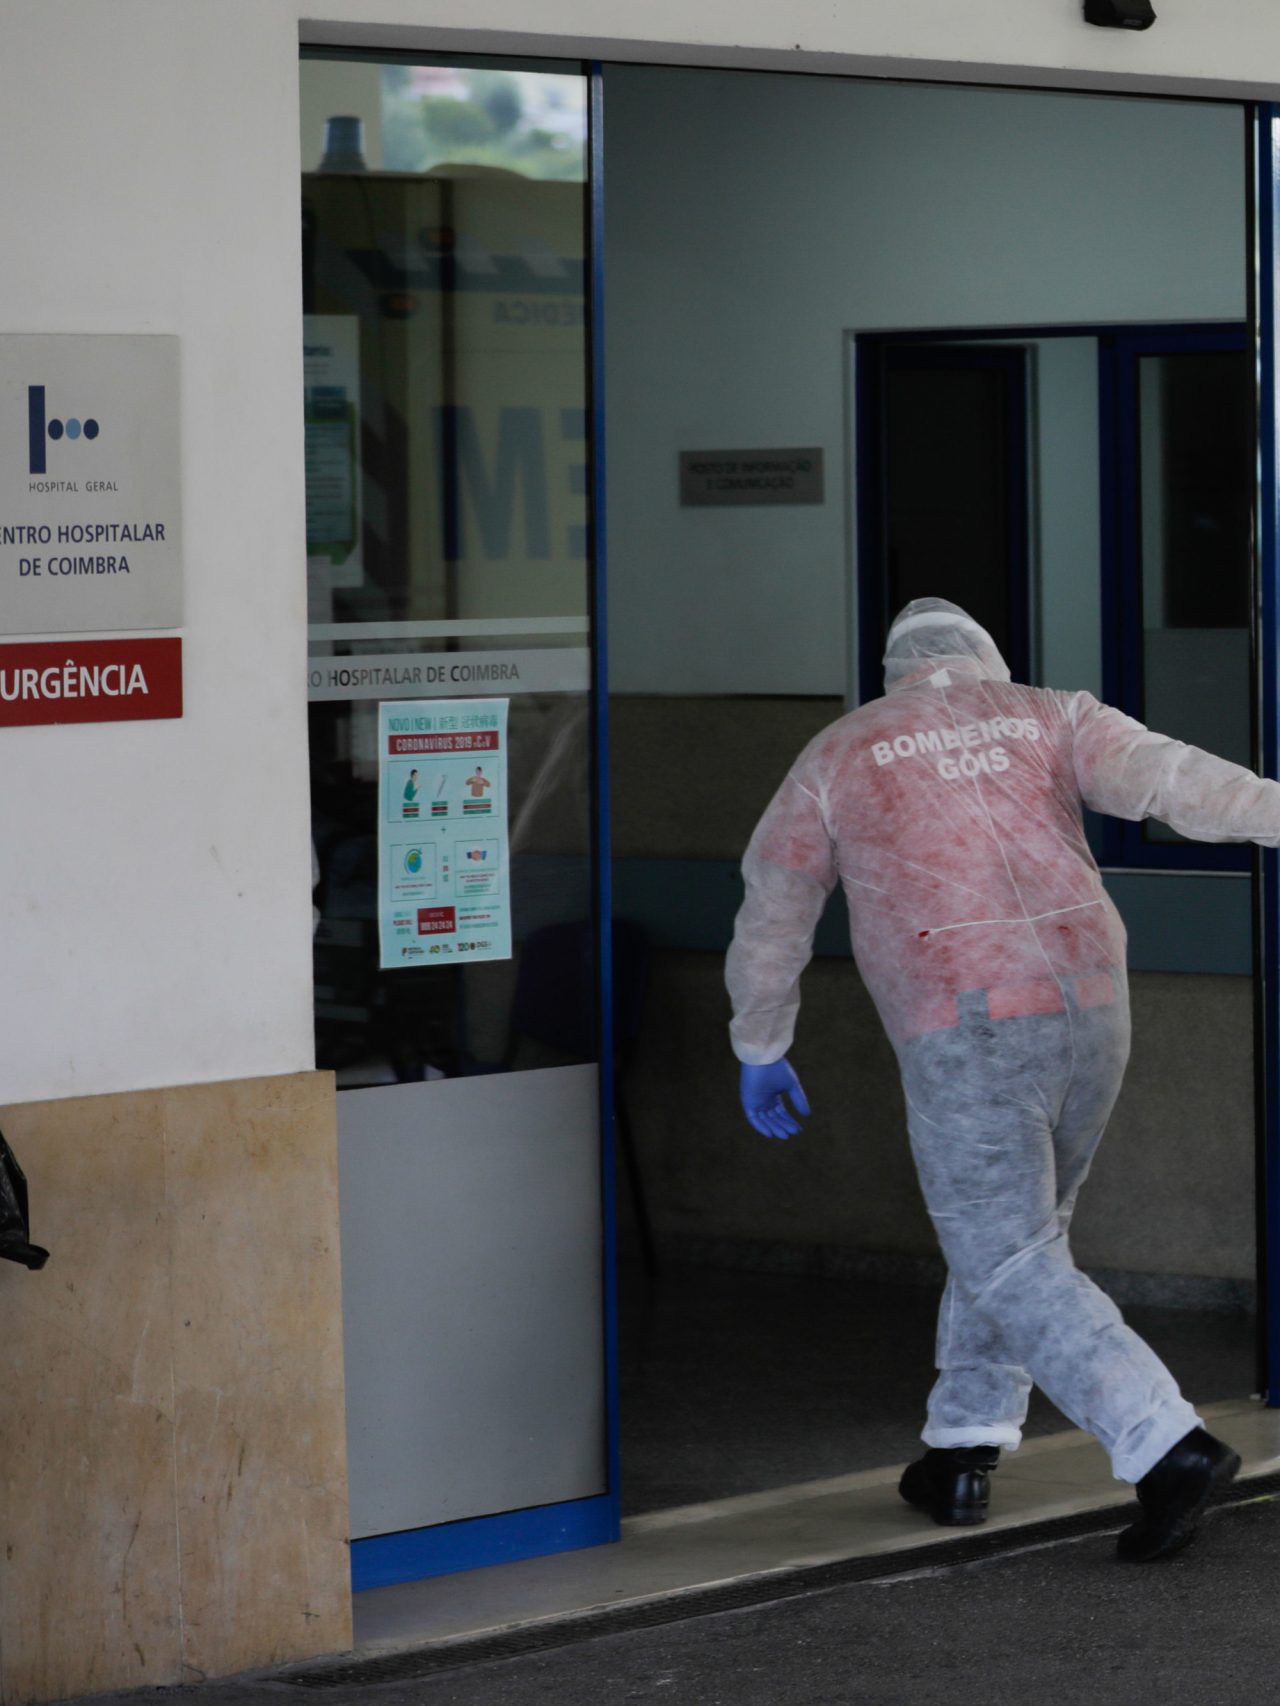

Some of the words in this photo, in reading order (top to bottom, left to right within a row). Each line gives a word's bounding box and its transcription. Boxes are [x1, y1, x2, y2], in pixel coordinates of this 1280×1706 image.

[29, 481, 79, 493] HOSPITAL
[85, 480, 119, 492] GERAL
[0, 525, 51, 545] NTRO
[58, 523, 165, 544] HOSPITALAR
[19, 558, 42, 577] DE
[48, 556, 130, 576] COIMBRA
[0, 658, 149, 701] URGÊNCIA
[328, 666, 422, 688] HOSPITALAR
[426, 666, 446, 683] DE
[450, 663, 520, 682] COIMBRA
[871, 715, 1041, 768] BOMBEIROS
[937, 745, 1010, 781] GOIS
